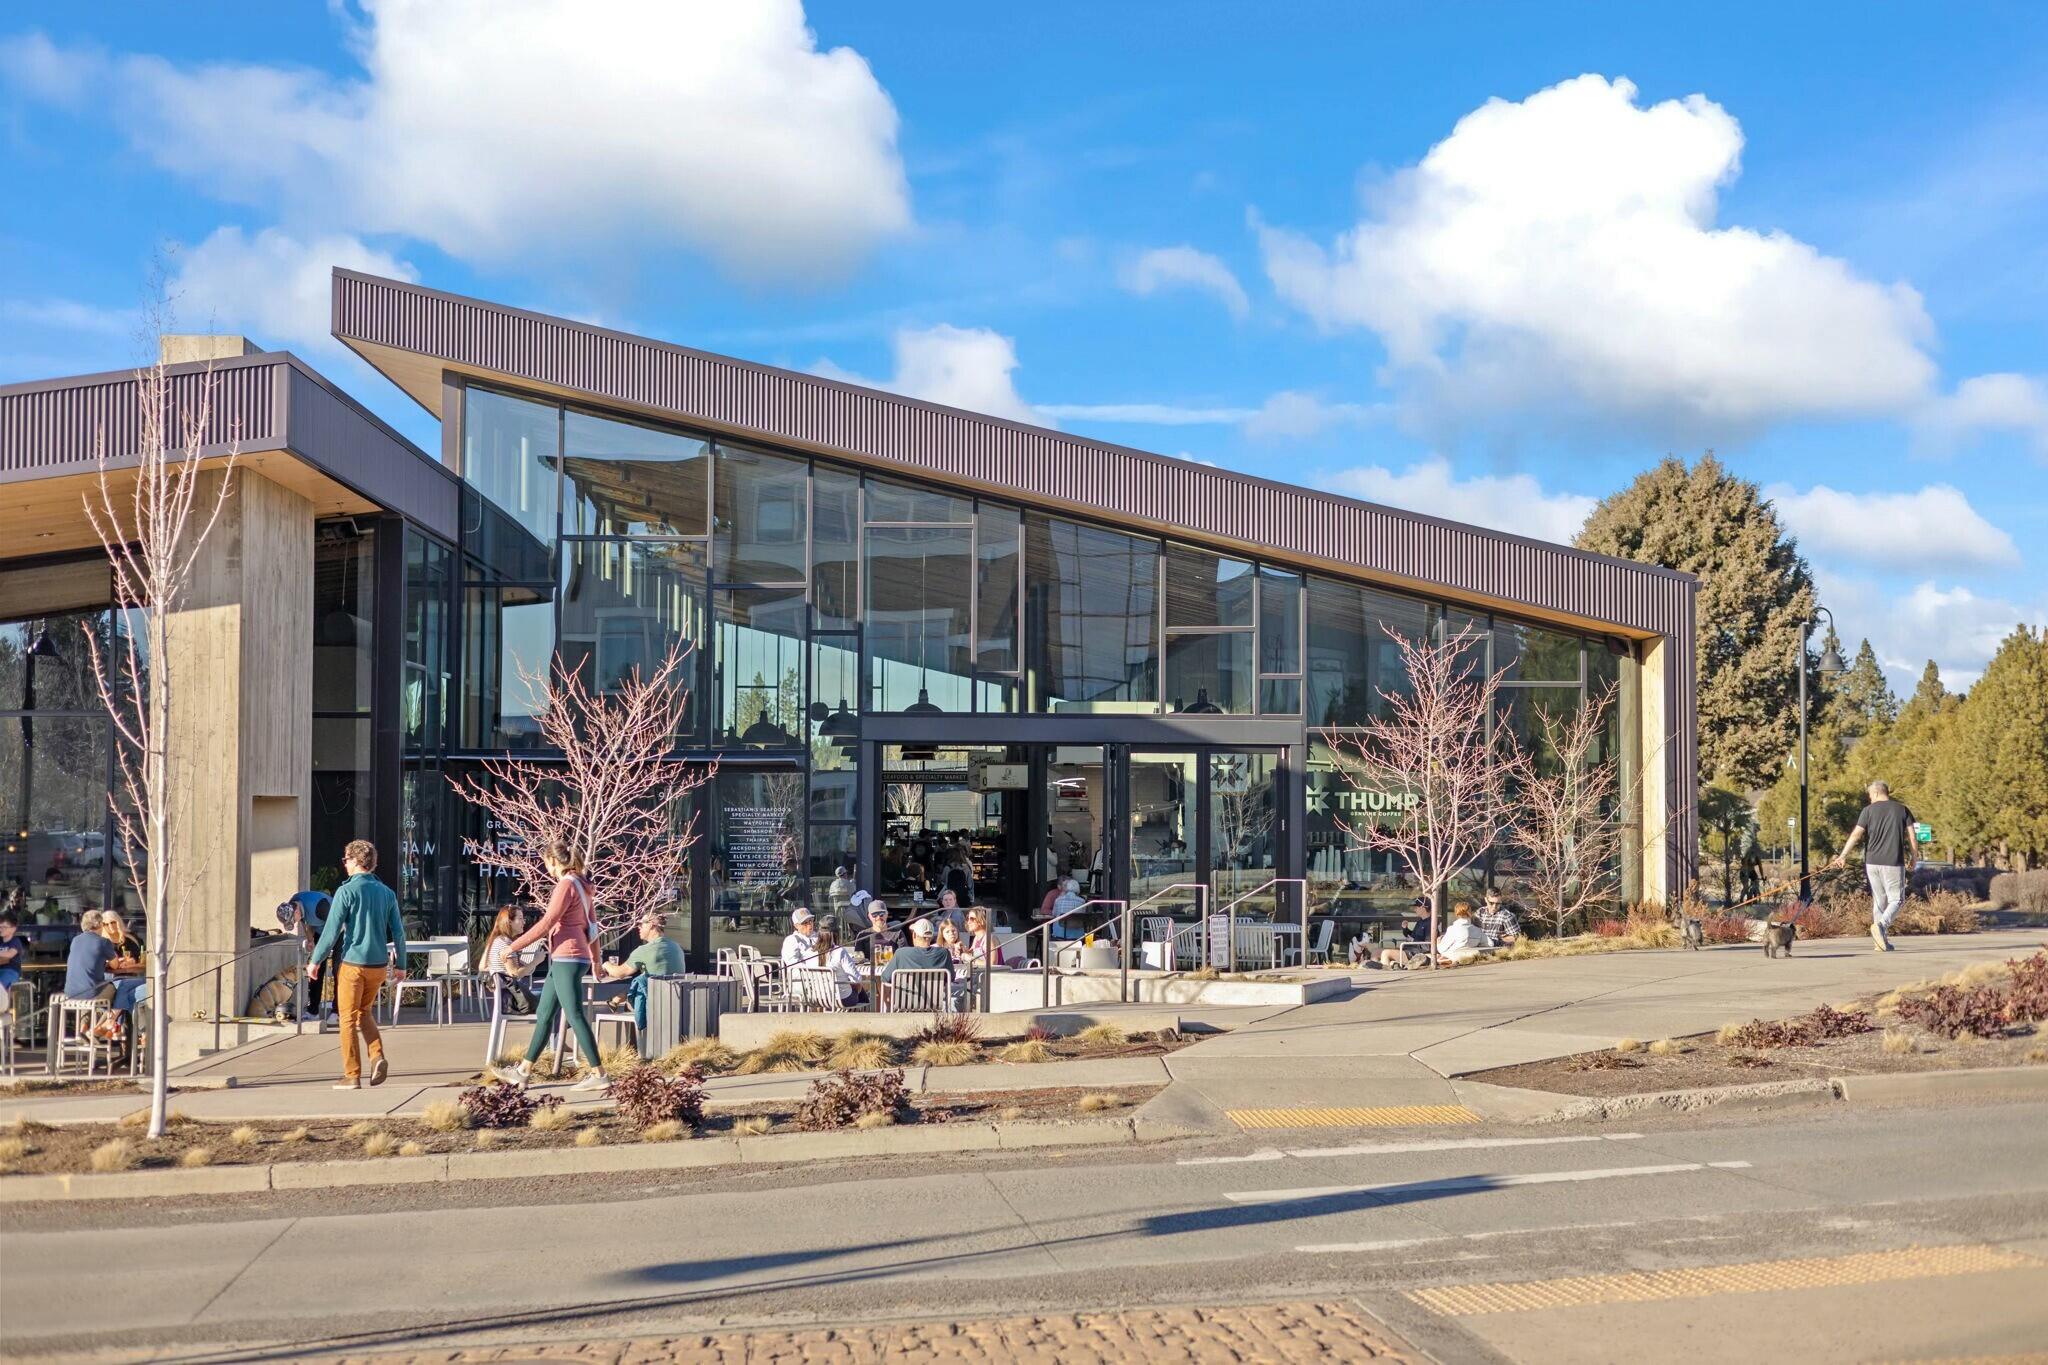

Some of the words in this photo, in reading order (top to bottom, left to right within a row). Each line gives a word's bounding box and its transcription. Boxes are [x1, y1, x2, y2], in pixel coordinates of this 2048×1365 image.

[1334, 792, 1420, 811] THUMP
[486, 820, 526, 829] GROE
[462, 841, 540, 857] MARKE
[479, 862, 524, 878] HAL
